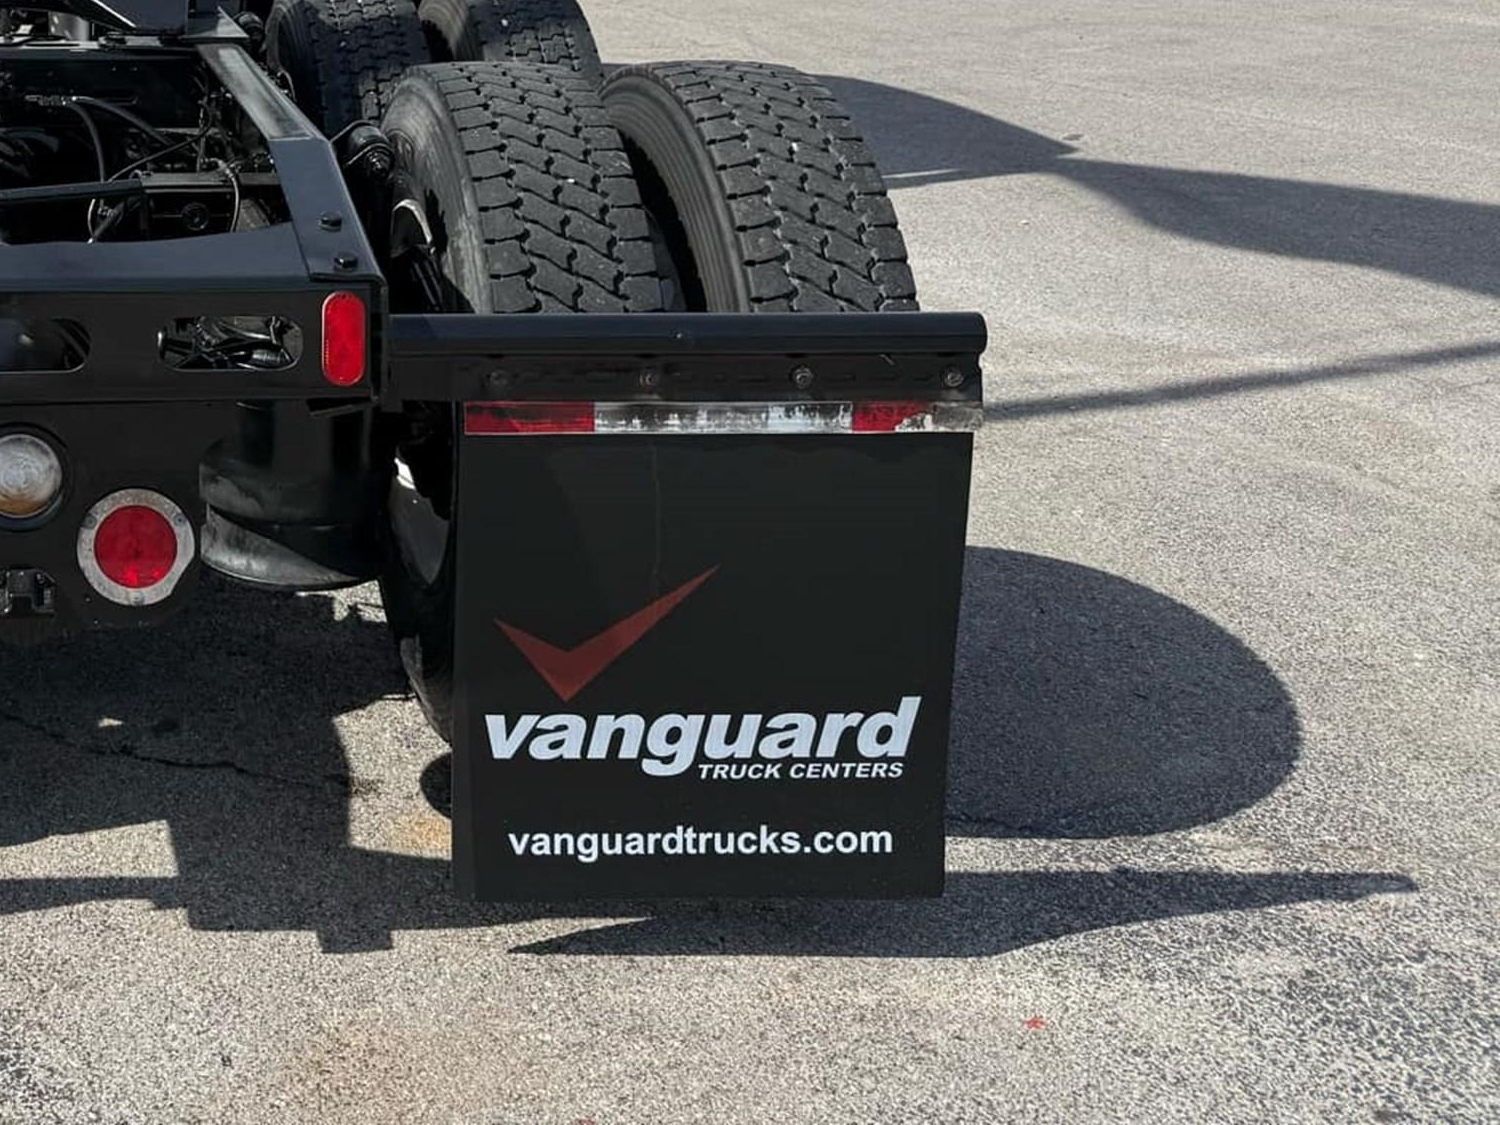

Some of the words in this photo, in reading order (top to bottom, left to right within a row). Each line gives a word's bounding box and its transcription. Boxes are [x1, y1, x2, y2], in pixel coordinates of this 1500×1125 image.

[484, 696, 922, 777] vanguard
[698, 763, 781, 780] TRUCK
[789, 762, 904, 779] CENTERS
[508, 825, 894, 863] vanguardtrucks.com
